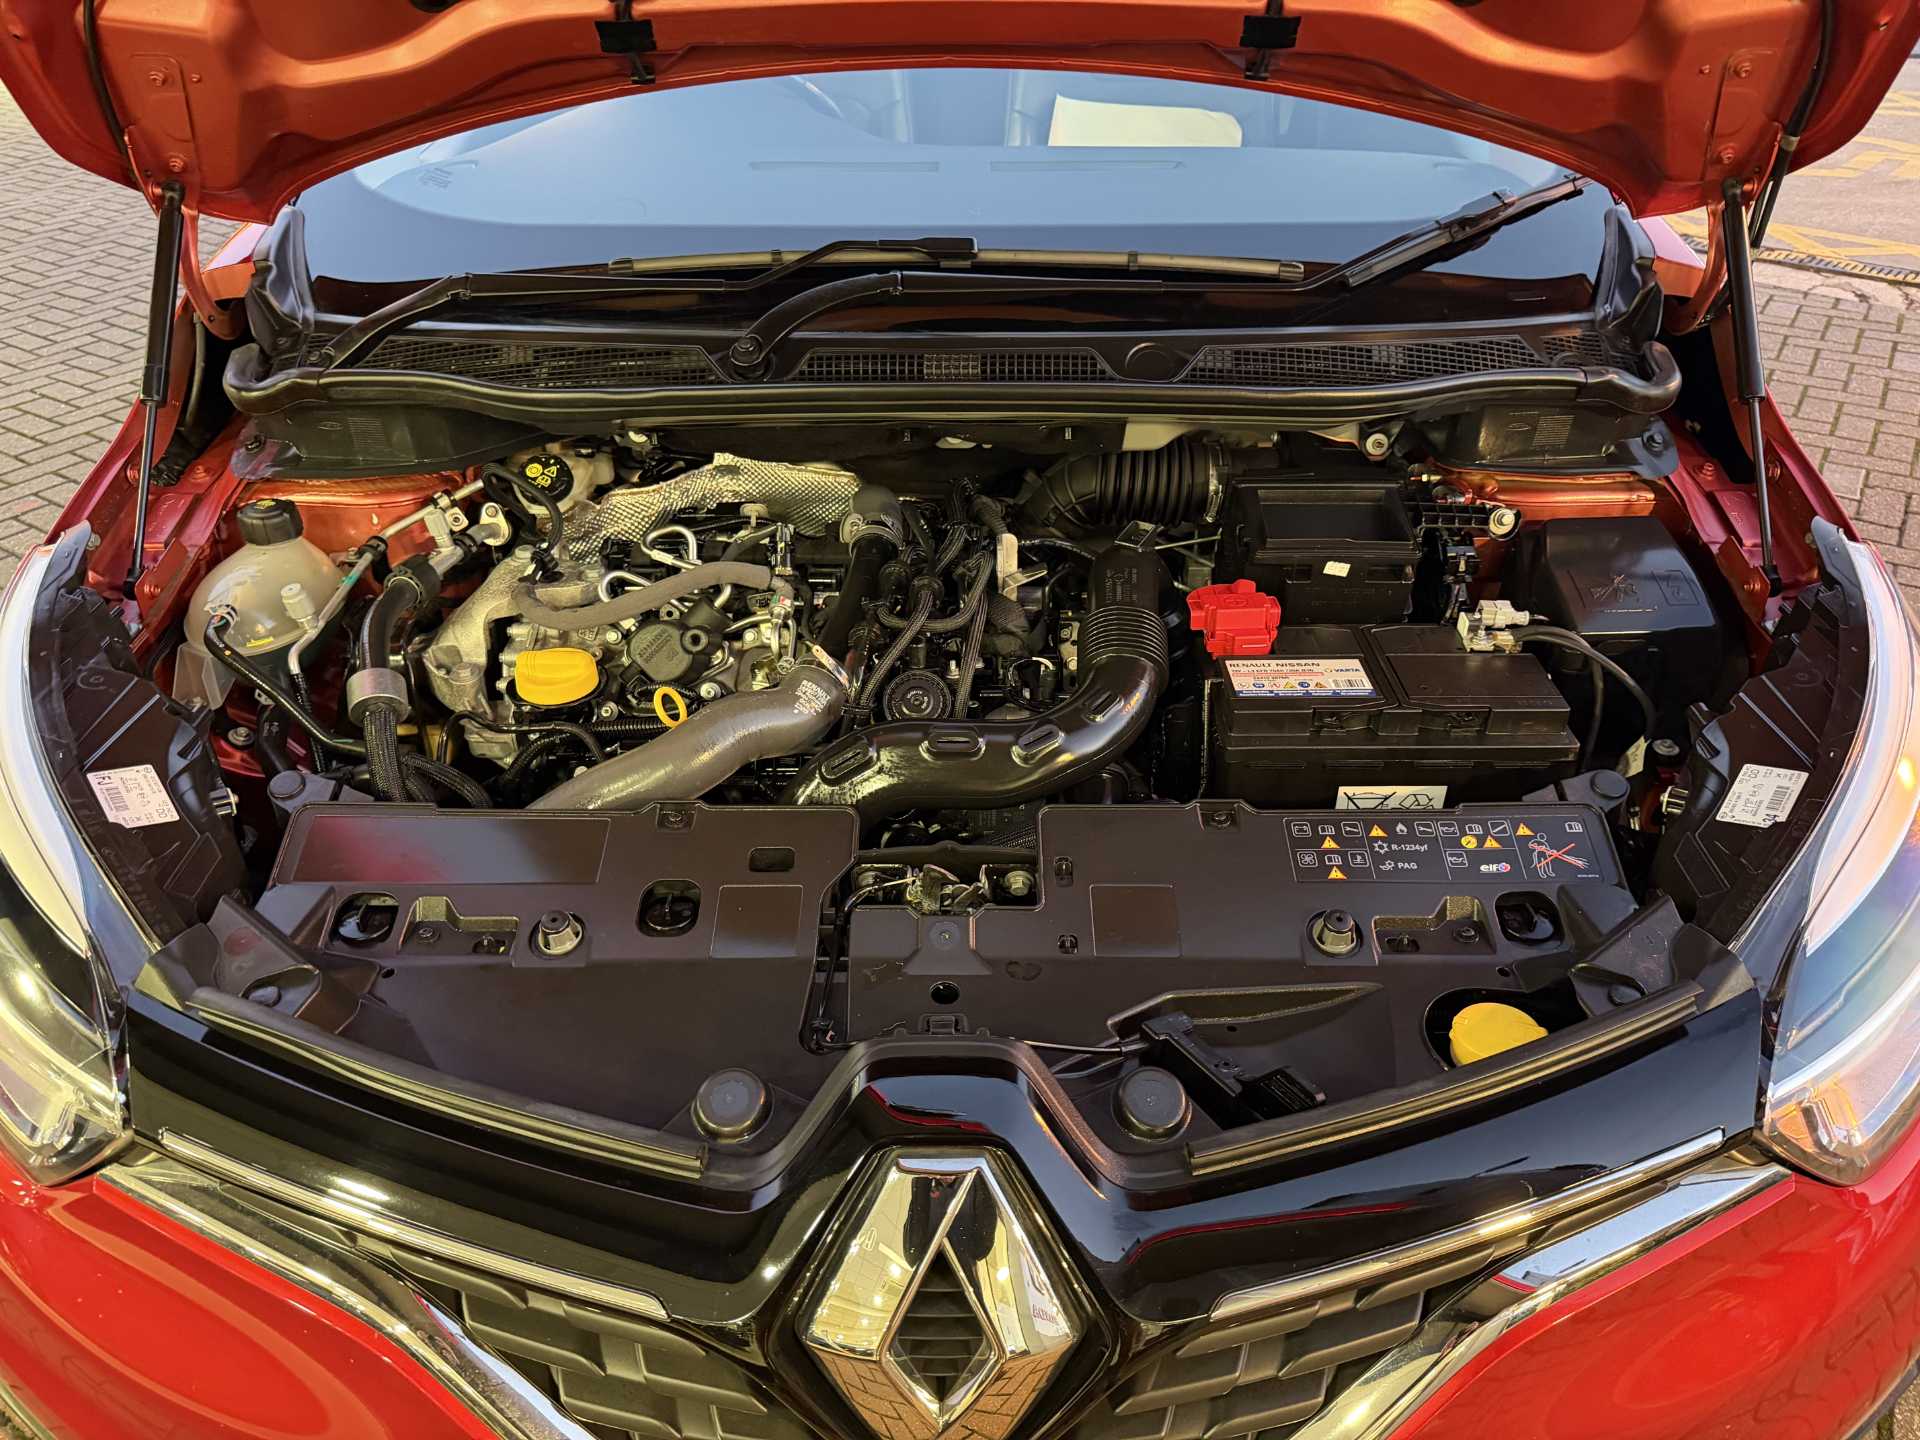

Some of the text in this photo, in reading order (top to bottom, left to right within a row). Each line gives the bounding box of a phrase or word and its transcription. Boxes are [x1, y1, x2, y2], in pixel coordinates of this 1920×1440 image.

[1391, 844, 1428, 852] R-1234yf
[1398, 862, 1418, 870] PAG
[1480, 863, 1499, 871] elf
